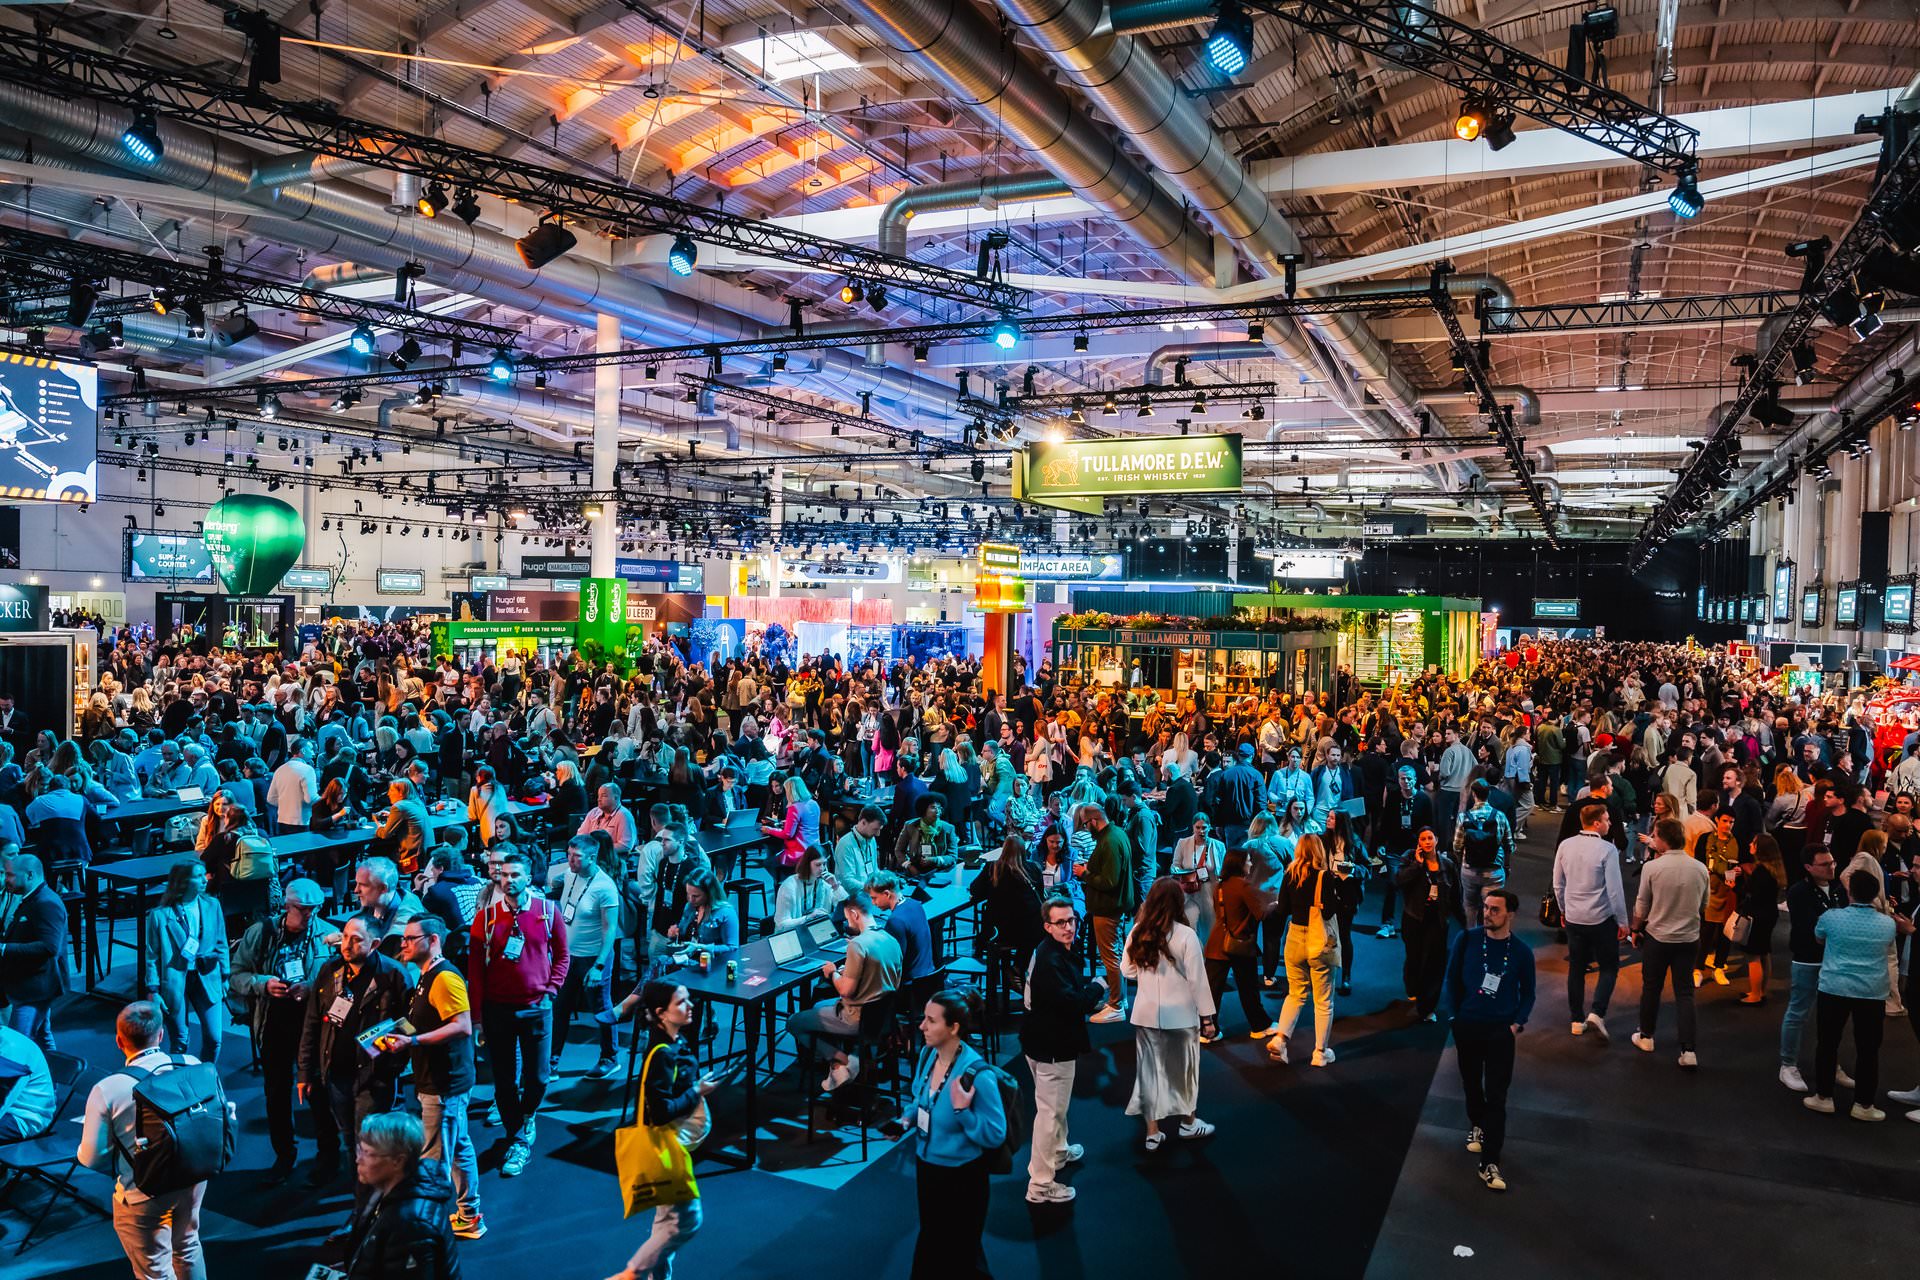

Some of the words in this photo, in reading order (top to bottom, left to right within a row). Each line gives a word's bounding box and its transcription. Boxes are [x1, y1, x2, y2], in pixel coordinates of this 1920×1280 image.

[1081, 454, 1175, 473] TULLAMORE
[1113, 473, 1140, 482] IRISH
[1143, 472, 1189, 481] WHISKEY
[158, 560, 187, 568] COUNTER
[522, 562, 546, 573] hugo!
[549, 563, 570, 572] CHARGING
[571, 564, 588, 572] LOUNGE
[1020, 562, 1059, 572] IMPACT
[1060, 562, 1089, 572] AREA
[495, 596, 515, 604] hugo!
[516, 596, 526, 604] ONE
[586, 583, 599, 623] Carlsberg
[610, 583, 622, 623] Carlsberg
[633, 608, 654, 619] LEER?
[1135, 632, 1190, 645] TULLAMORE
[1192, 633, 1211, 646] PUB
